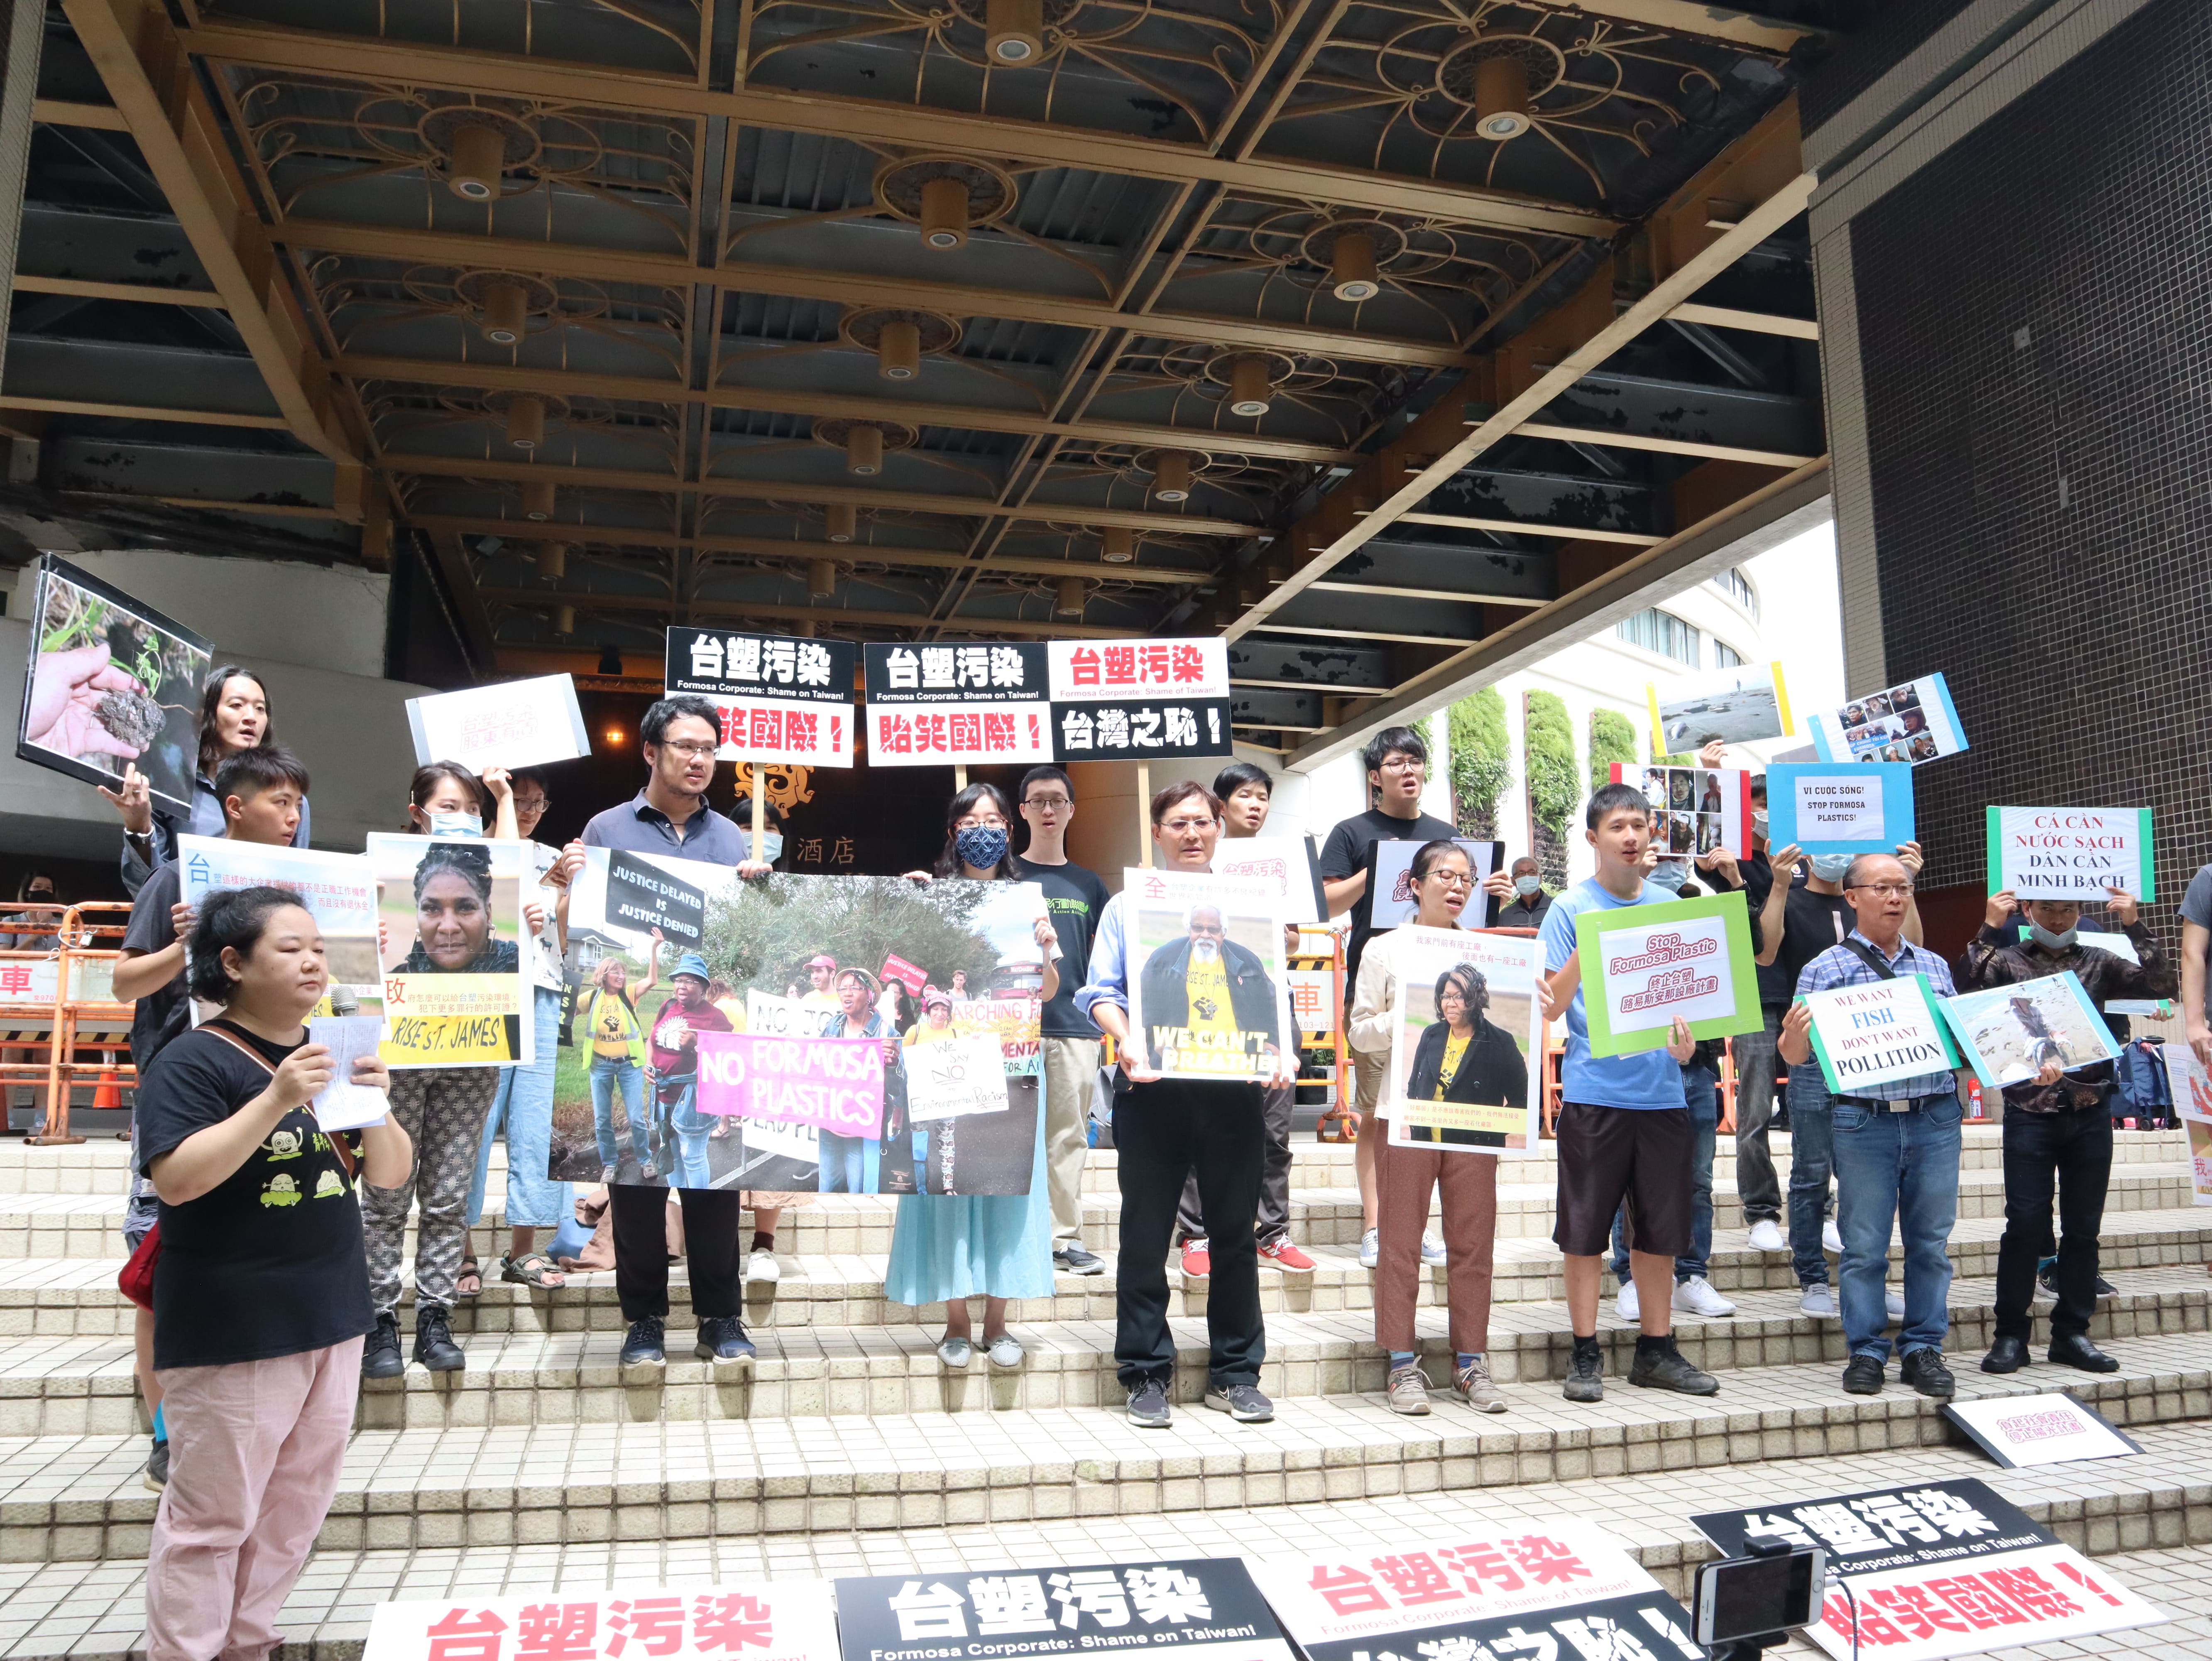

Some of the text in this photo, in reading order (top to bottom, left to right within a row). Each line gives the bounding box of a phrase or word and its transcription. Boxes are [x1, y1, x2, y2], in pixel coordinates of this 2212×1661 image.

[690, 634, 831, 686] 台塑污染
[886, 647, 1024, 688] 台塑污染
[1070, 644, 1204, 686] 台塑污染
[677, 680, 717, 691] Formosa
[719, 684, 765, 694] Corporate:
[767, 686, 797, 697] Shame
[812, 690, 844, 700] Taiwan!
[876, 692, 914, 701] Formosa
[916, 692, 962, 702] Corporate:
[964, 691, 993, 700] Shame
[1008, 690, 1039, 699] Taiwan!
[1099, 689, 1143, 698] Corporate:
[879, 712, 1040, 753] 貽笑國際！
[1062, 707, 1221, 750] 台灣之恥！
[1803, 784, 1864, 796] VÌ CUỘC SỐNG!
[2035, 813, 2103, 828] CÁ CẦN
[797, 836, 855, 865] 酒店
[2016, 832, 2124, 851] NƯỚC SẠCH
[2030, 851, 2111, 868] DÂN CẦN
[612, 866, 702, 909] JUSTICE DELAYED
[2018, 874, 2124, 891] MINH BẠCH
[656, 898, 667, 911] IS
[618, 904, 699, 938] JUSTICE DENIED
[1648, 934, 1679, 952] Stop
[888, 959, 927, 980] JUSTICE DELAYED
[1462, 951, 1527, 967] 後面也有一座工廠
[1612, 939, 1716, 974] Formosa Plastic
[0, 965, 33, 995] 車
[385, 978, 406, 1004] 政
[1650, 969, 1693, 990] 終止台塑
[419, 1003, 517, 1013] 犯下更多罪行的許可證？
[1292, 982, 1322, 1017] 車
[1835, 988, 1893, 1007] WE WANT
[756, 1005, 788, 1033] NO
[1852, 1007, 1894, 1029] FISH
[392, 1017, 427, 1047] RISE
[450, 1017, 499, 1049] JAMES
[1153, 1026, 1189, 1048] WE
[1881, 1027, 1918, 1043] WANT
[933, 1041, 956, 1053] WE
[950, 1053, 969, 1063] SAY
[1836, 1042, 1941, 1077] POLLITION
[702, 1051, 745, 1085] NO
[753, 1040, 882, 1082] FORMOSA
[932, 1065, 965, 1080] NO
[753, 1080, 875, 1126] PLASTICS
[973, 1087, 1008, 1109] Racism
[2195, 1158, 2207, 1176] 我
[1840, 1554, 1919, 1572] Corporate:
[1921, 1544, 1970, 1561] Shame
[1972, 1542, 1989, 1552] on
[1990, 1533, 2043, 1549] Taiwan!
[1307, 1535, 1593, 1617] 台塑污染
[888, 1567, 1212, 1641] 台塑污染
[1321, 1580, 1634, 1635] Formosa Corporate: Shame of Taiwan!
[427, 1592, 775, 1661] 台塑污染
[871, 1624, 1256, 1661] Formosa Corporate: Shame on Taiwan!
